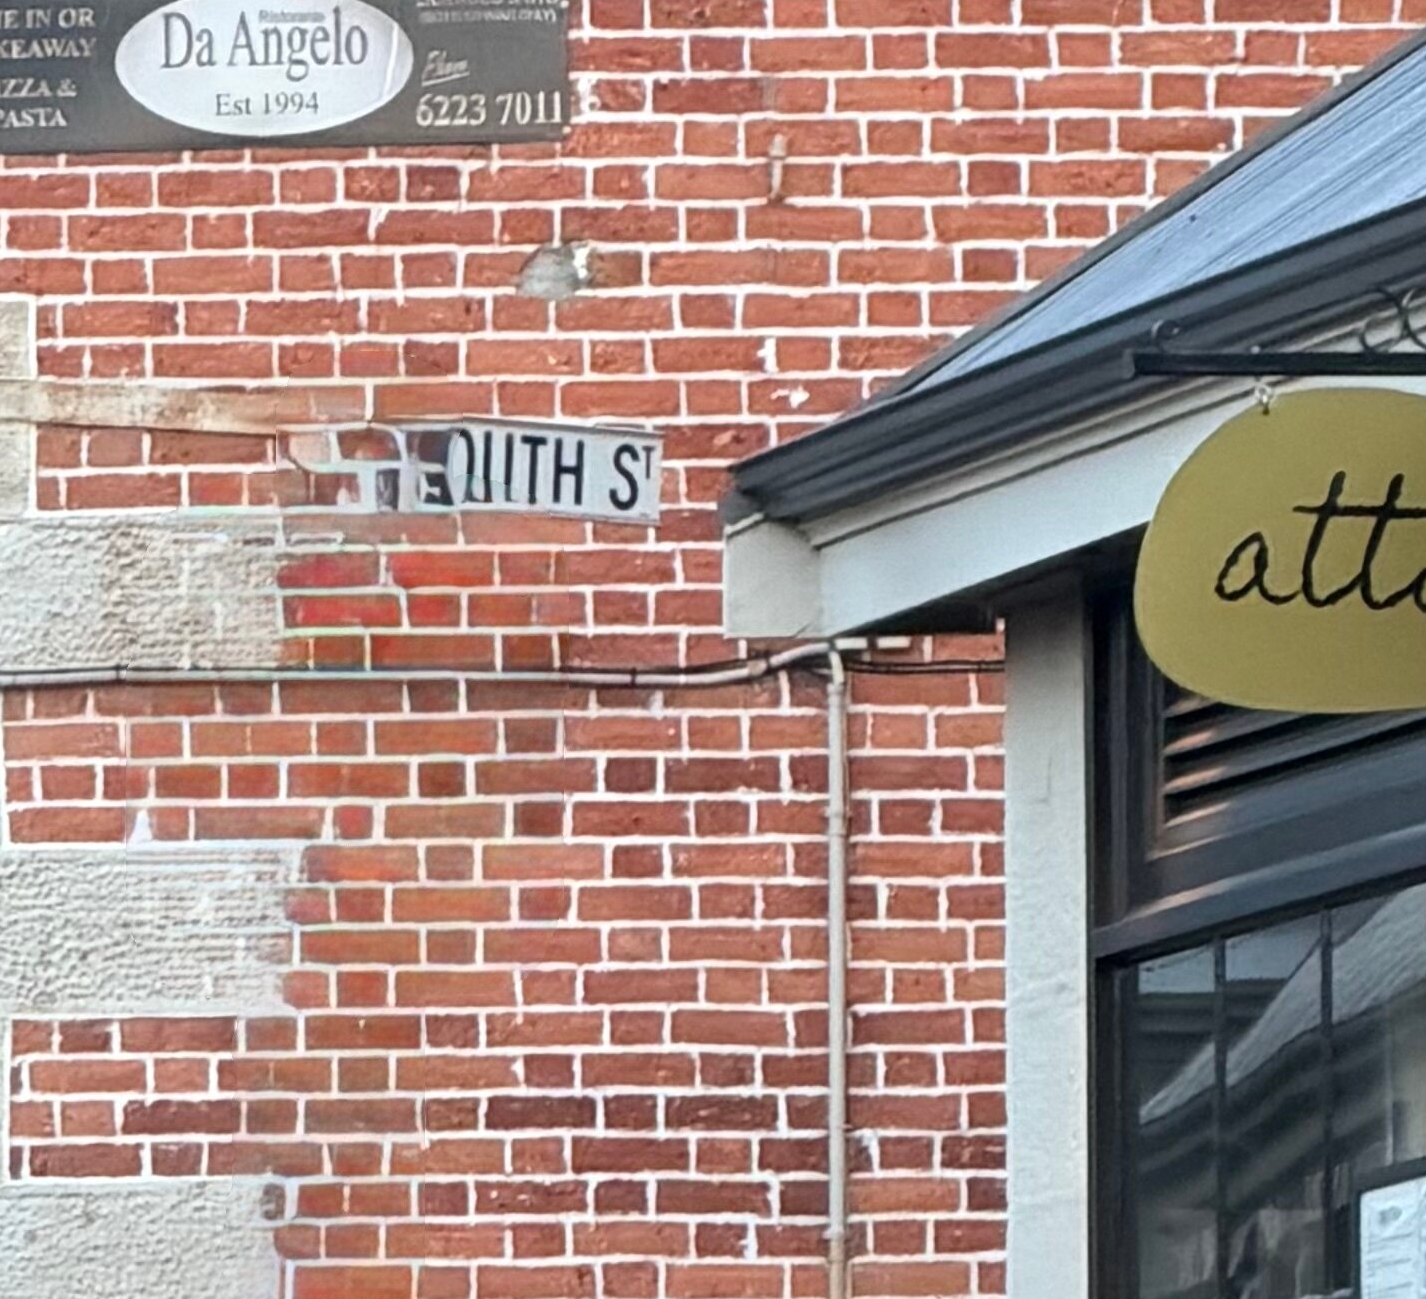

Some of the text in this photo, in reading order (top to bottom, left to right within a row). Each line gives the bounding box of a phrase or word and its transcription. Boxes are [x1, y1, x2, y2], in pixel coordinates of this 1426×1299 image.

[25, 8, 52, 29] IN
[58, 7, 96, 29] OR
[160, 5, 369, 82] Da Angelo
[56, 78, 78, 97] &
[215, 91, 319, 117] Est 1994
[416, 90, 562, 127] 6223 7011
